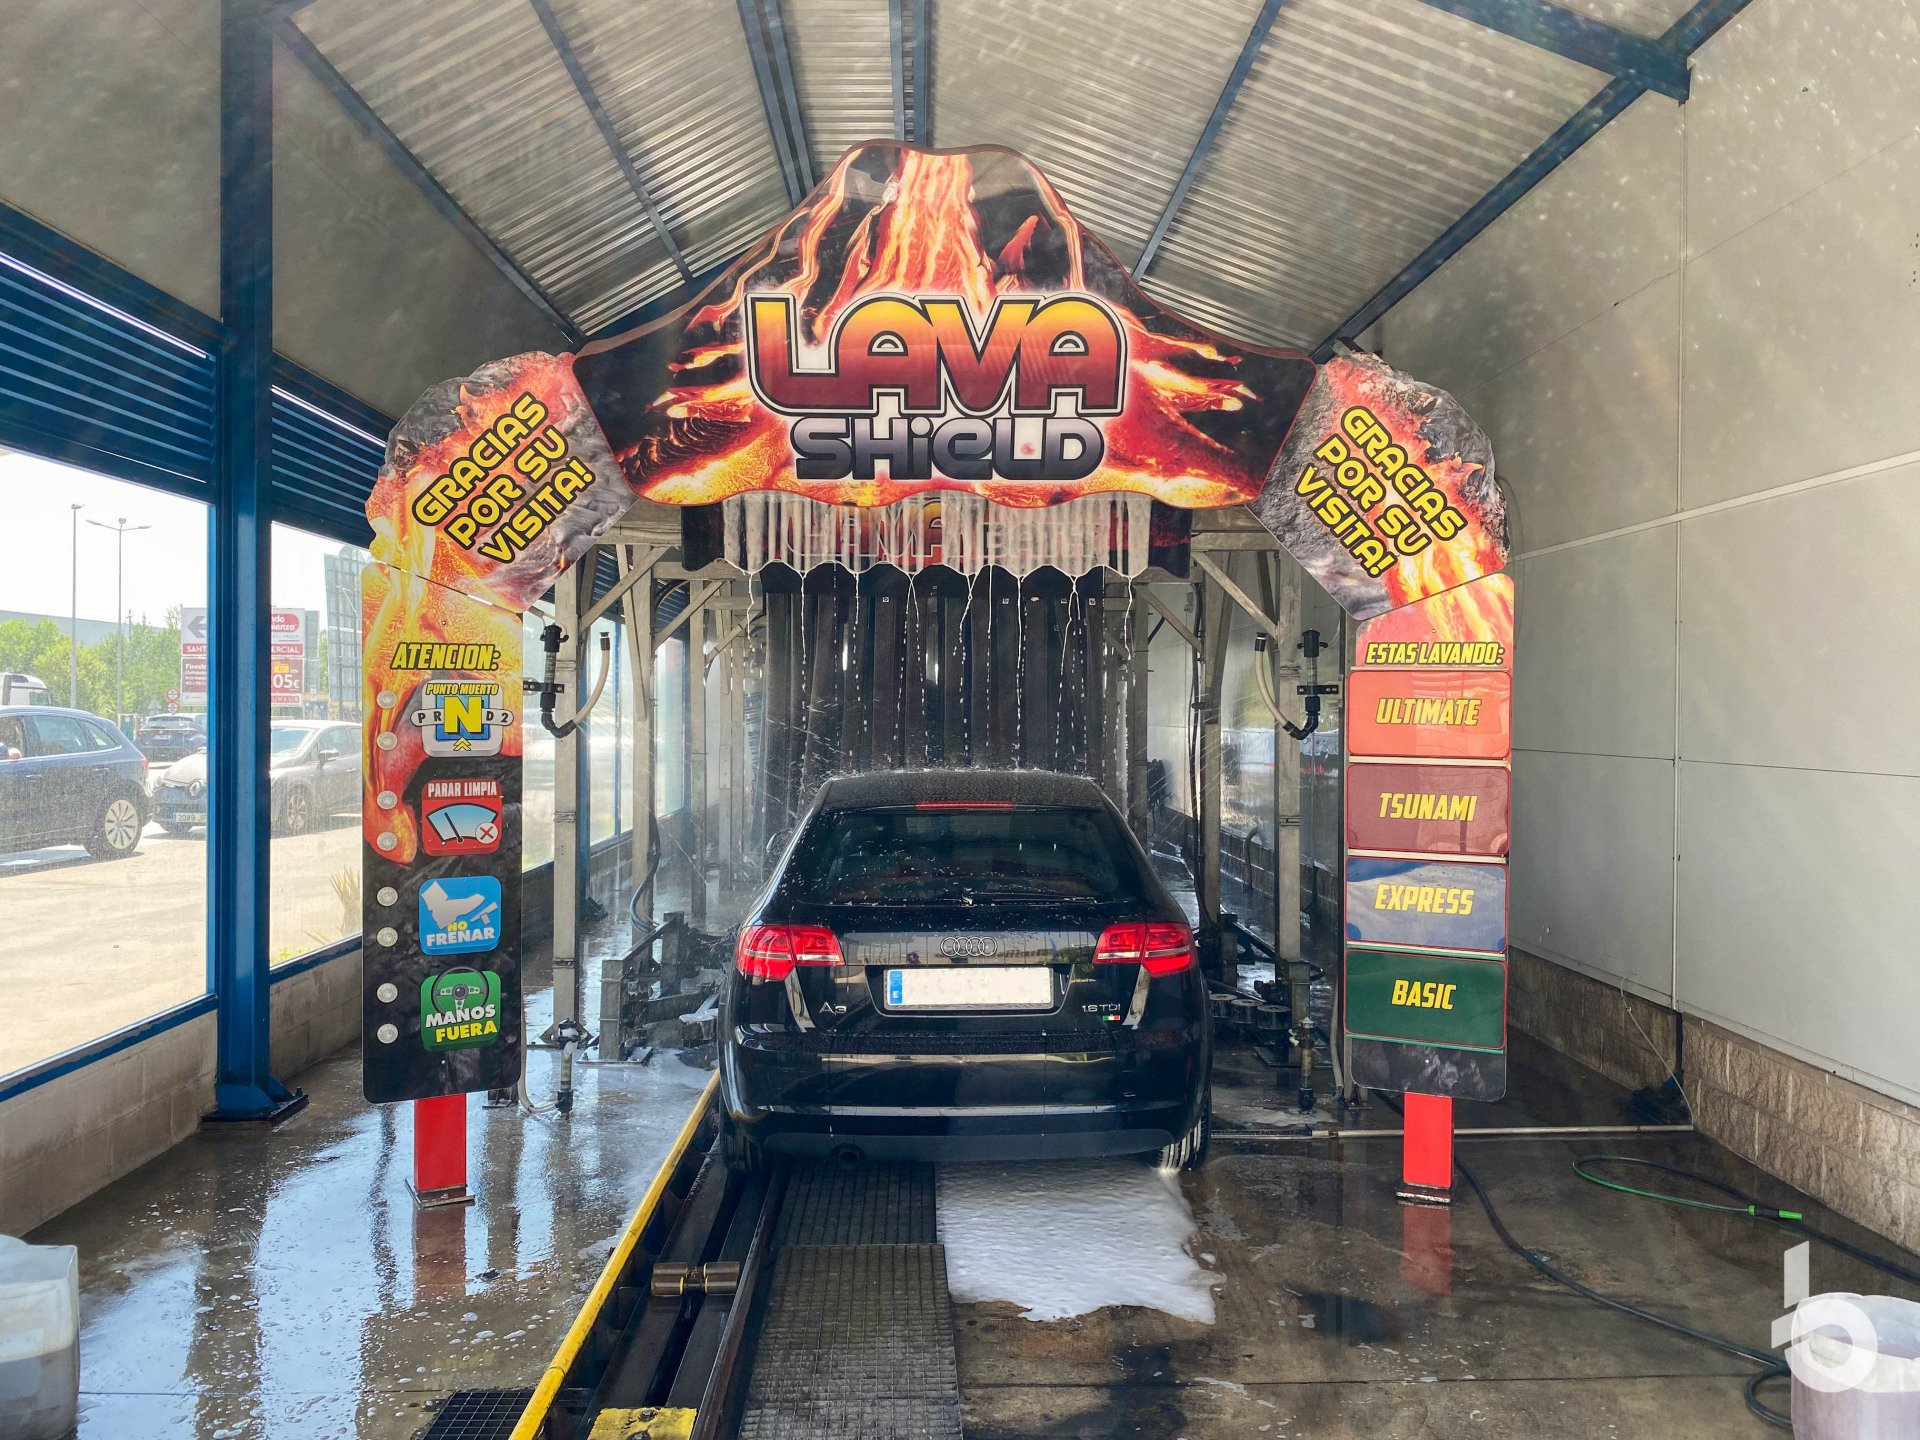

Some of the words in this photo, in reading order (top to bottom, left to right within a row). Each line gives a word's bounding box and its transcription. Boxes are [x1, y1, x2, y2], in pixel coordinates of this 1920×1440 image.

[747, 294, 1126, 416] LAVA
[413, 392, 547, 525] GRACIAS
[1341, 405, 1467, 540] GRACIAS
[445, 475, 525, 549] POR
[515, 426, 568, 482] SU
[1314, 434, 1385, 511] POR
[1375, 504, 1432, 555] SU
[479, 457, 595, 562] VISITA!
[1296, 463, 1398, 577] VISITA!
[391, 643, 500, 671] ATENCION:
[1366, 642, 1418, 664] ESTAS
[1418, 642, 1504, 665] LAVANDO:
[426, 683, 460, 695] PUNTO
[460, 683, 499, 695] MUERTO
[417, 713, 426, 724] P
[433, 711, 442, 721] R
[444, 696, 484, 734] N
[486, 711, 494, 721] D
[501, 713, 509, 723] 2
[1376, 698, 1482, 725] ULTIMATE
[428, 783, 461, 797] PARAR
[464, 782, 497, 796] LIMPIA
[1379, 792, 1477, 822] TSUNAMI
[1374, 883, 1475, 915] EXPRESS
[426, 927, 495, 947] FRENAR
[447, 921, 468, 932] NO
[819, 1001, 847, 1015] A3
[892, 990, 899, 998] E
[1099, 1003, 1121, 1011] TDI
[1391, 979, 1457, 1010] BASIC
[425, 1004, 496, 1028] MANOS
[435, 1020, 498, 1042] FUERA
